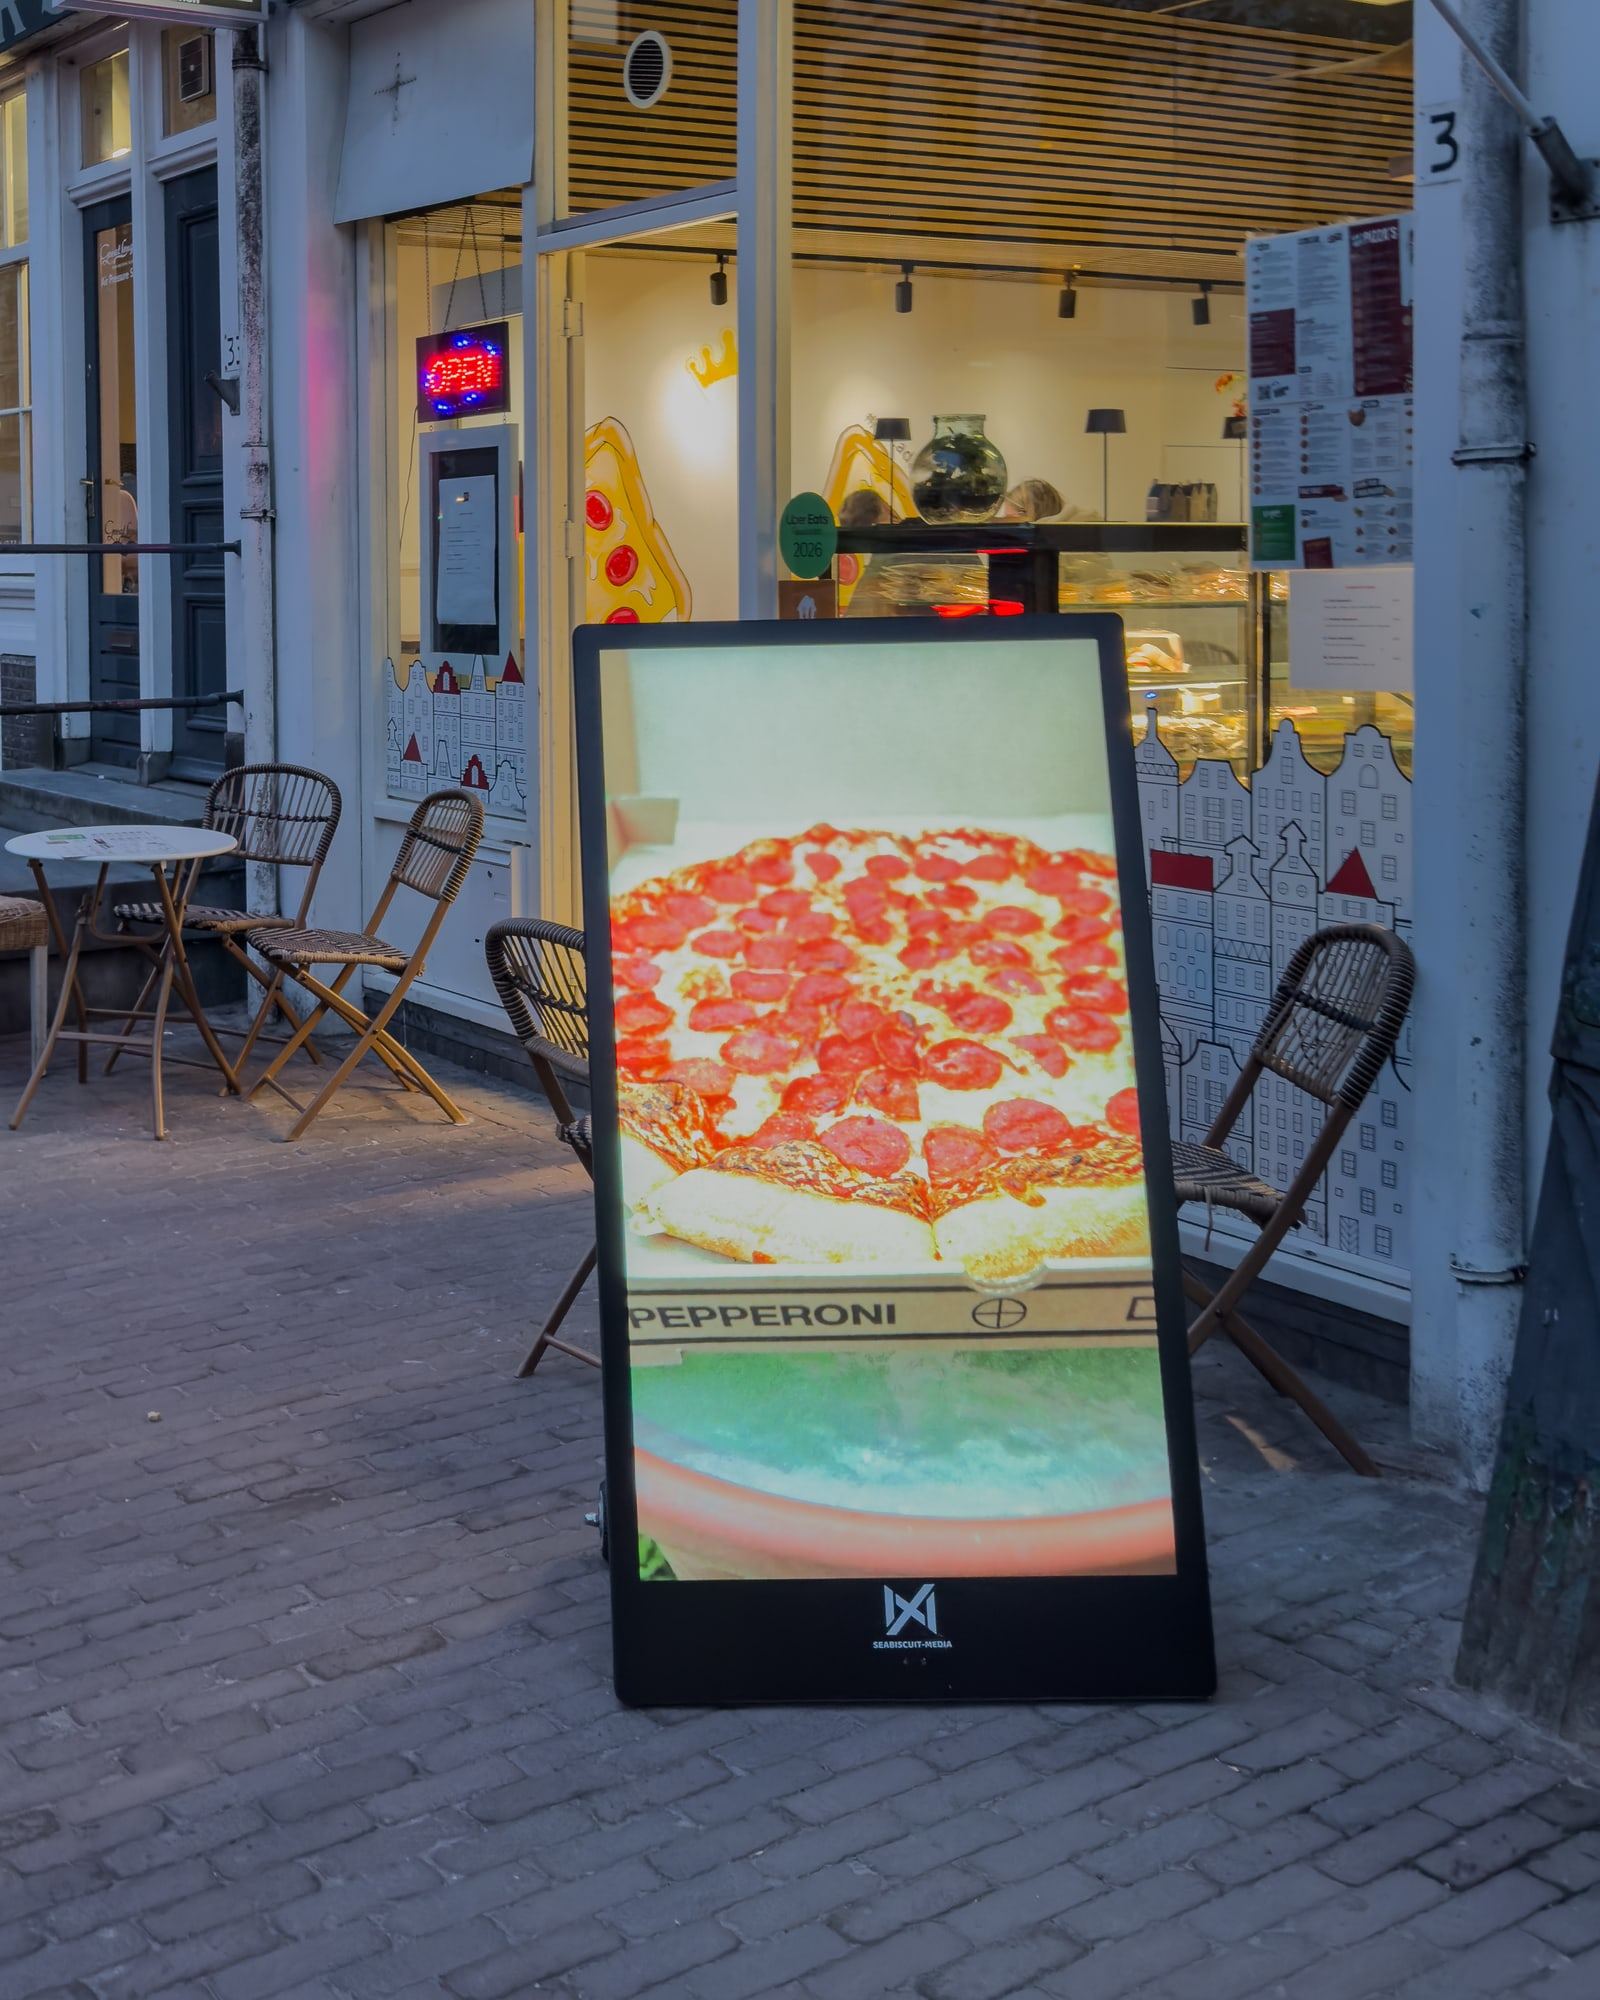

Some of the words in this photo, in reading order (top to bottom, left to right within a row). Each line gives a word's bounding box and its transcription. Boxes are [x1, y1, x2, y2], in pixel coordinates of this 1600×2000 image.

[1430, 111, 1458, 174] 3
[430, 355, 494, 393] OPEN
[807, 513, 829, 525] Eats
[793, 542, 823, 558] 2026
[629, 1302, 897, 1328] PEPPERONI
[873, 1640, 953, 1649] SEABISCUIT-MEDIA
